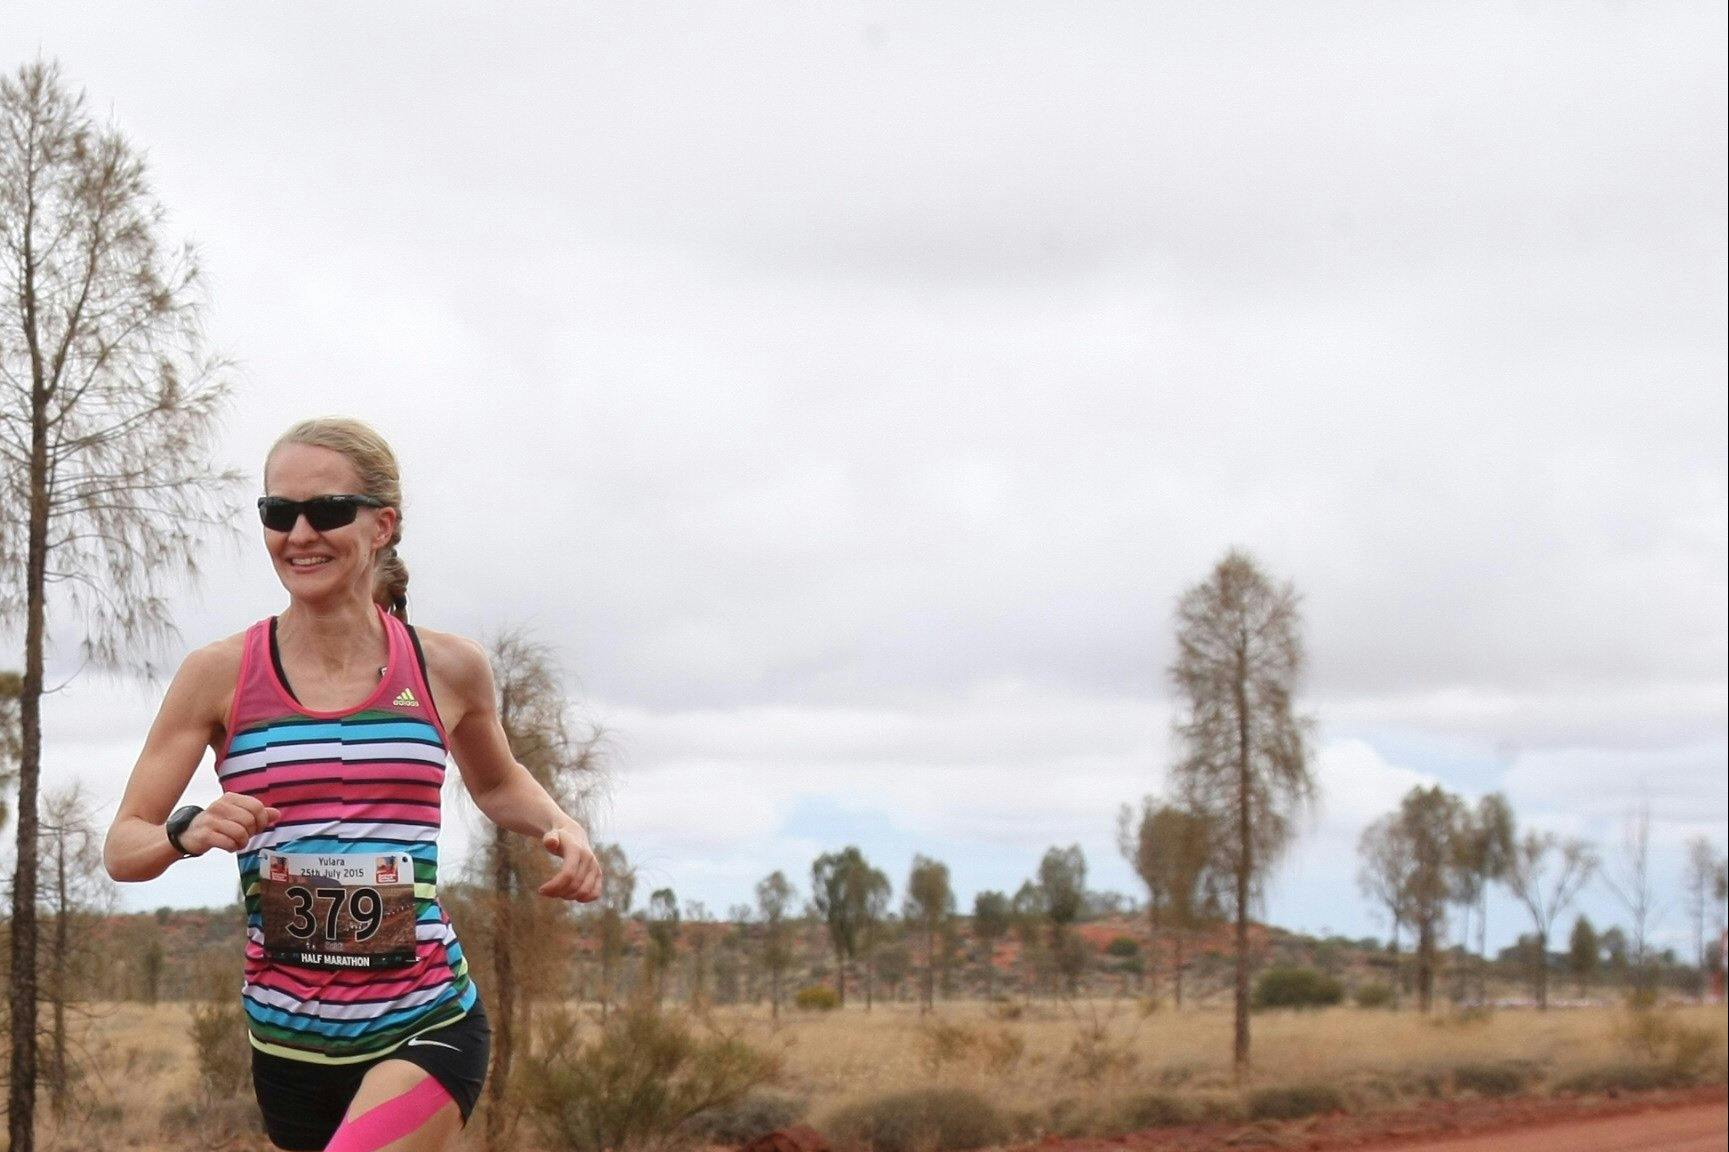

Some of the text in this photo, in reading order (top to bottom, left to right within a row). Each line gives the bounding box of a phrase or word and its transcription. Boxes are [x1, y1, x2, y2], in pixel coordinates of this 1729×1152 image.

[318, 857, 345, 866] Yulara
[301, 868, 364, 879] 25th July 2015
[285, 886, 383, 942] 379
[301, 953, 370, 967] HALF MARATHON
